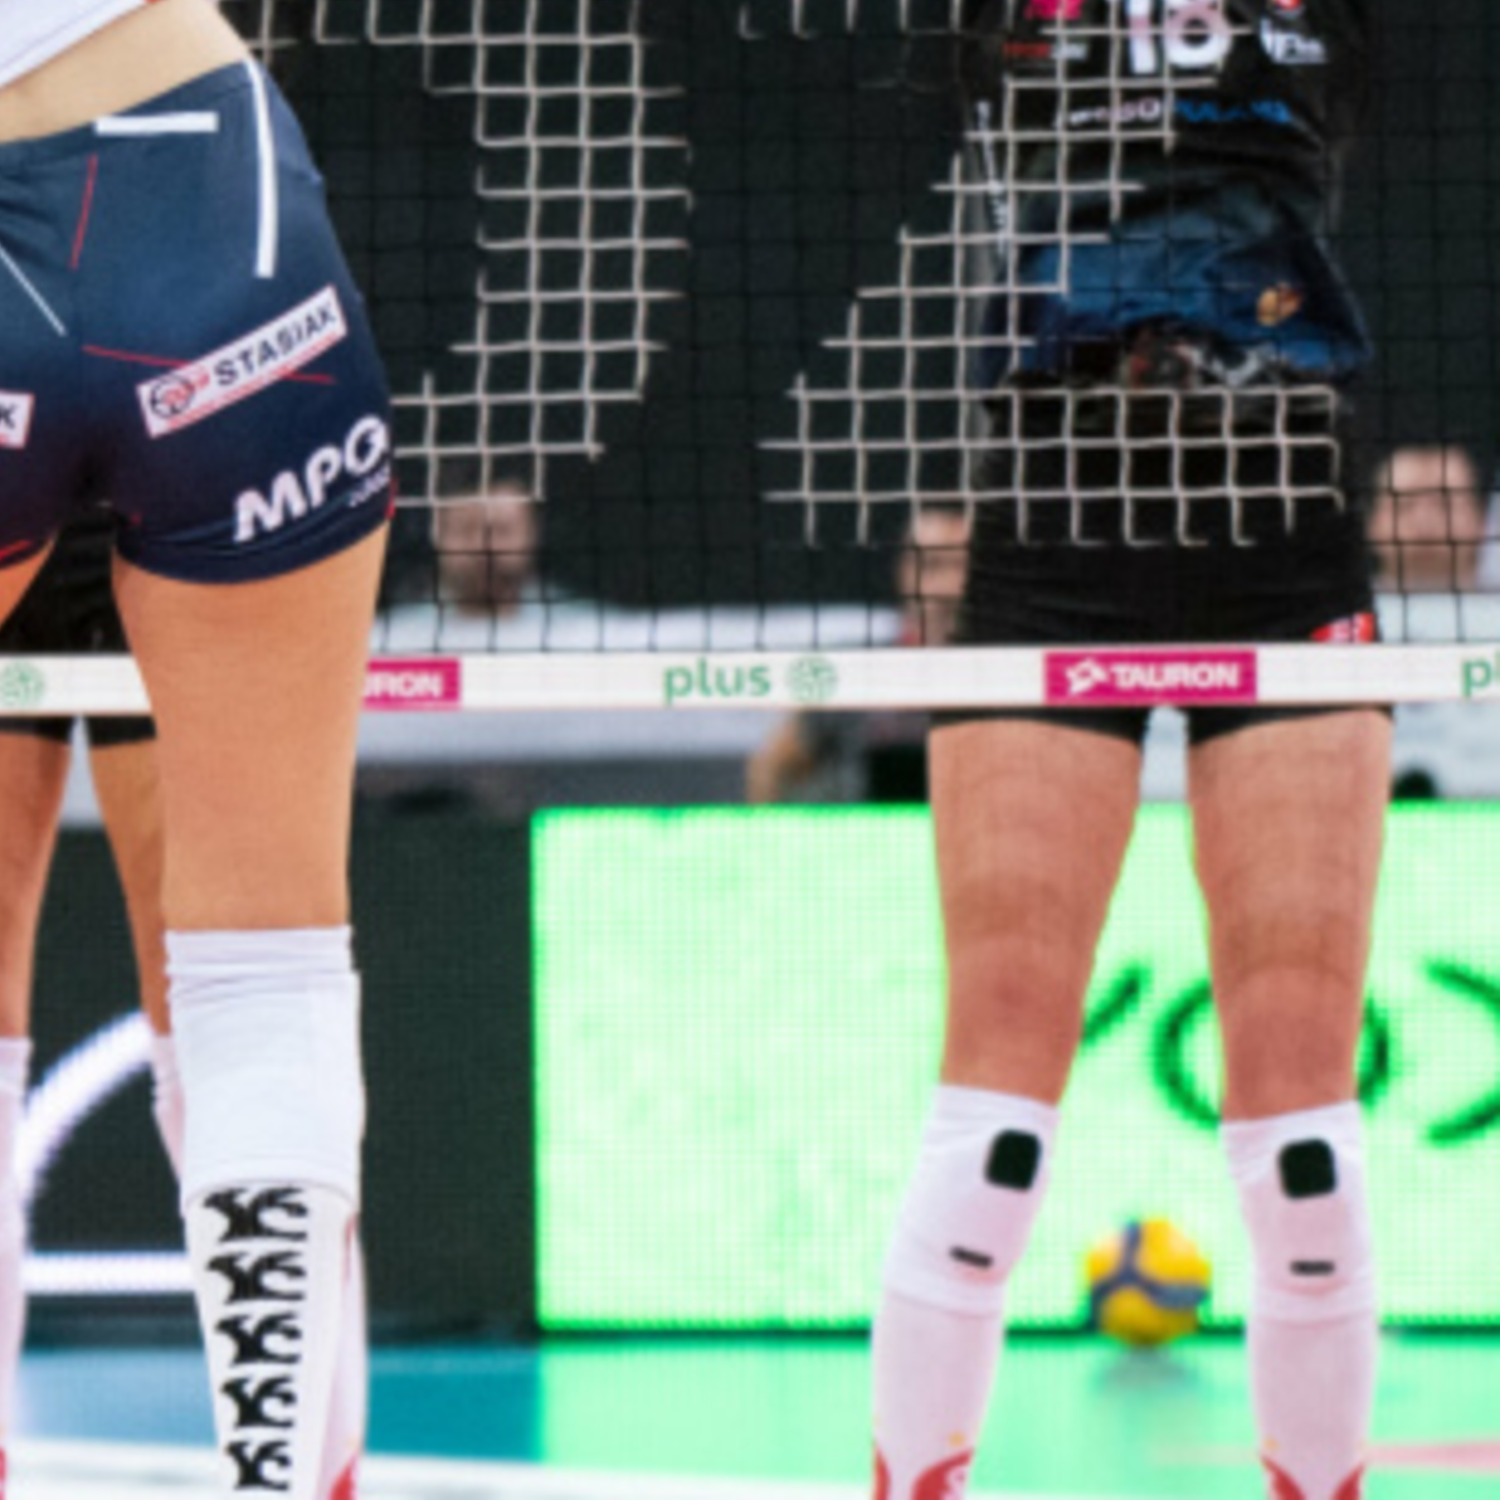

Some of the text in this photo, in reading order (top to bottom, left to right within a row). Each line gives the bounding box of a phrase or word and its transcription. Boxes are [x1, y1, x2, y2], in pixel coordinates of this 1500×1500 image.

[213, 302, 337, 387] STASIAK
[662, 655, 772, 702] plus
[1110, 663, 1240, 689] TAURON
